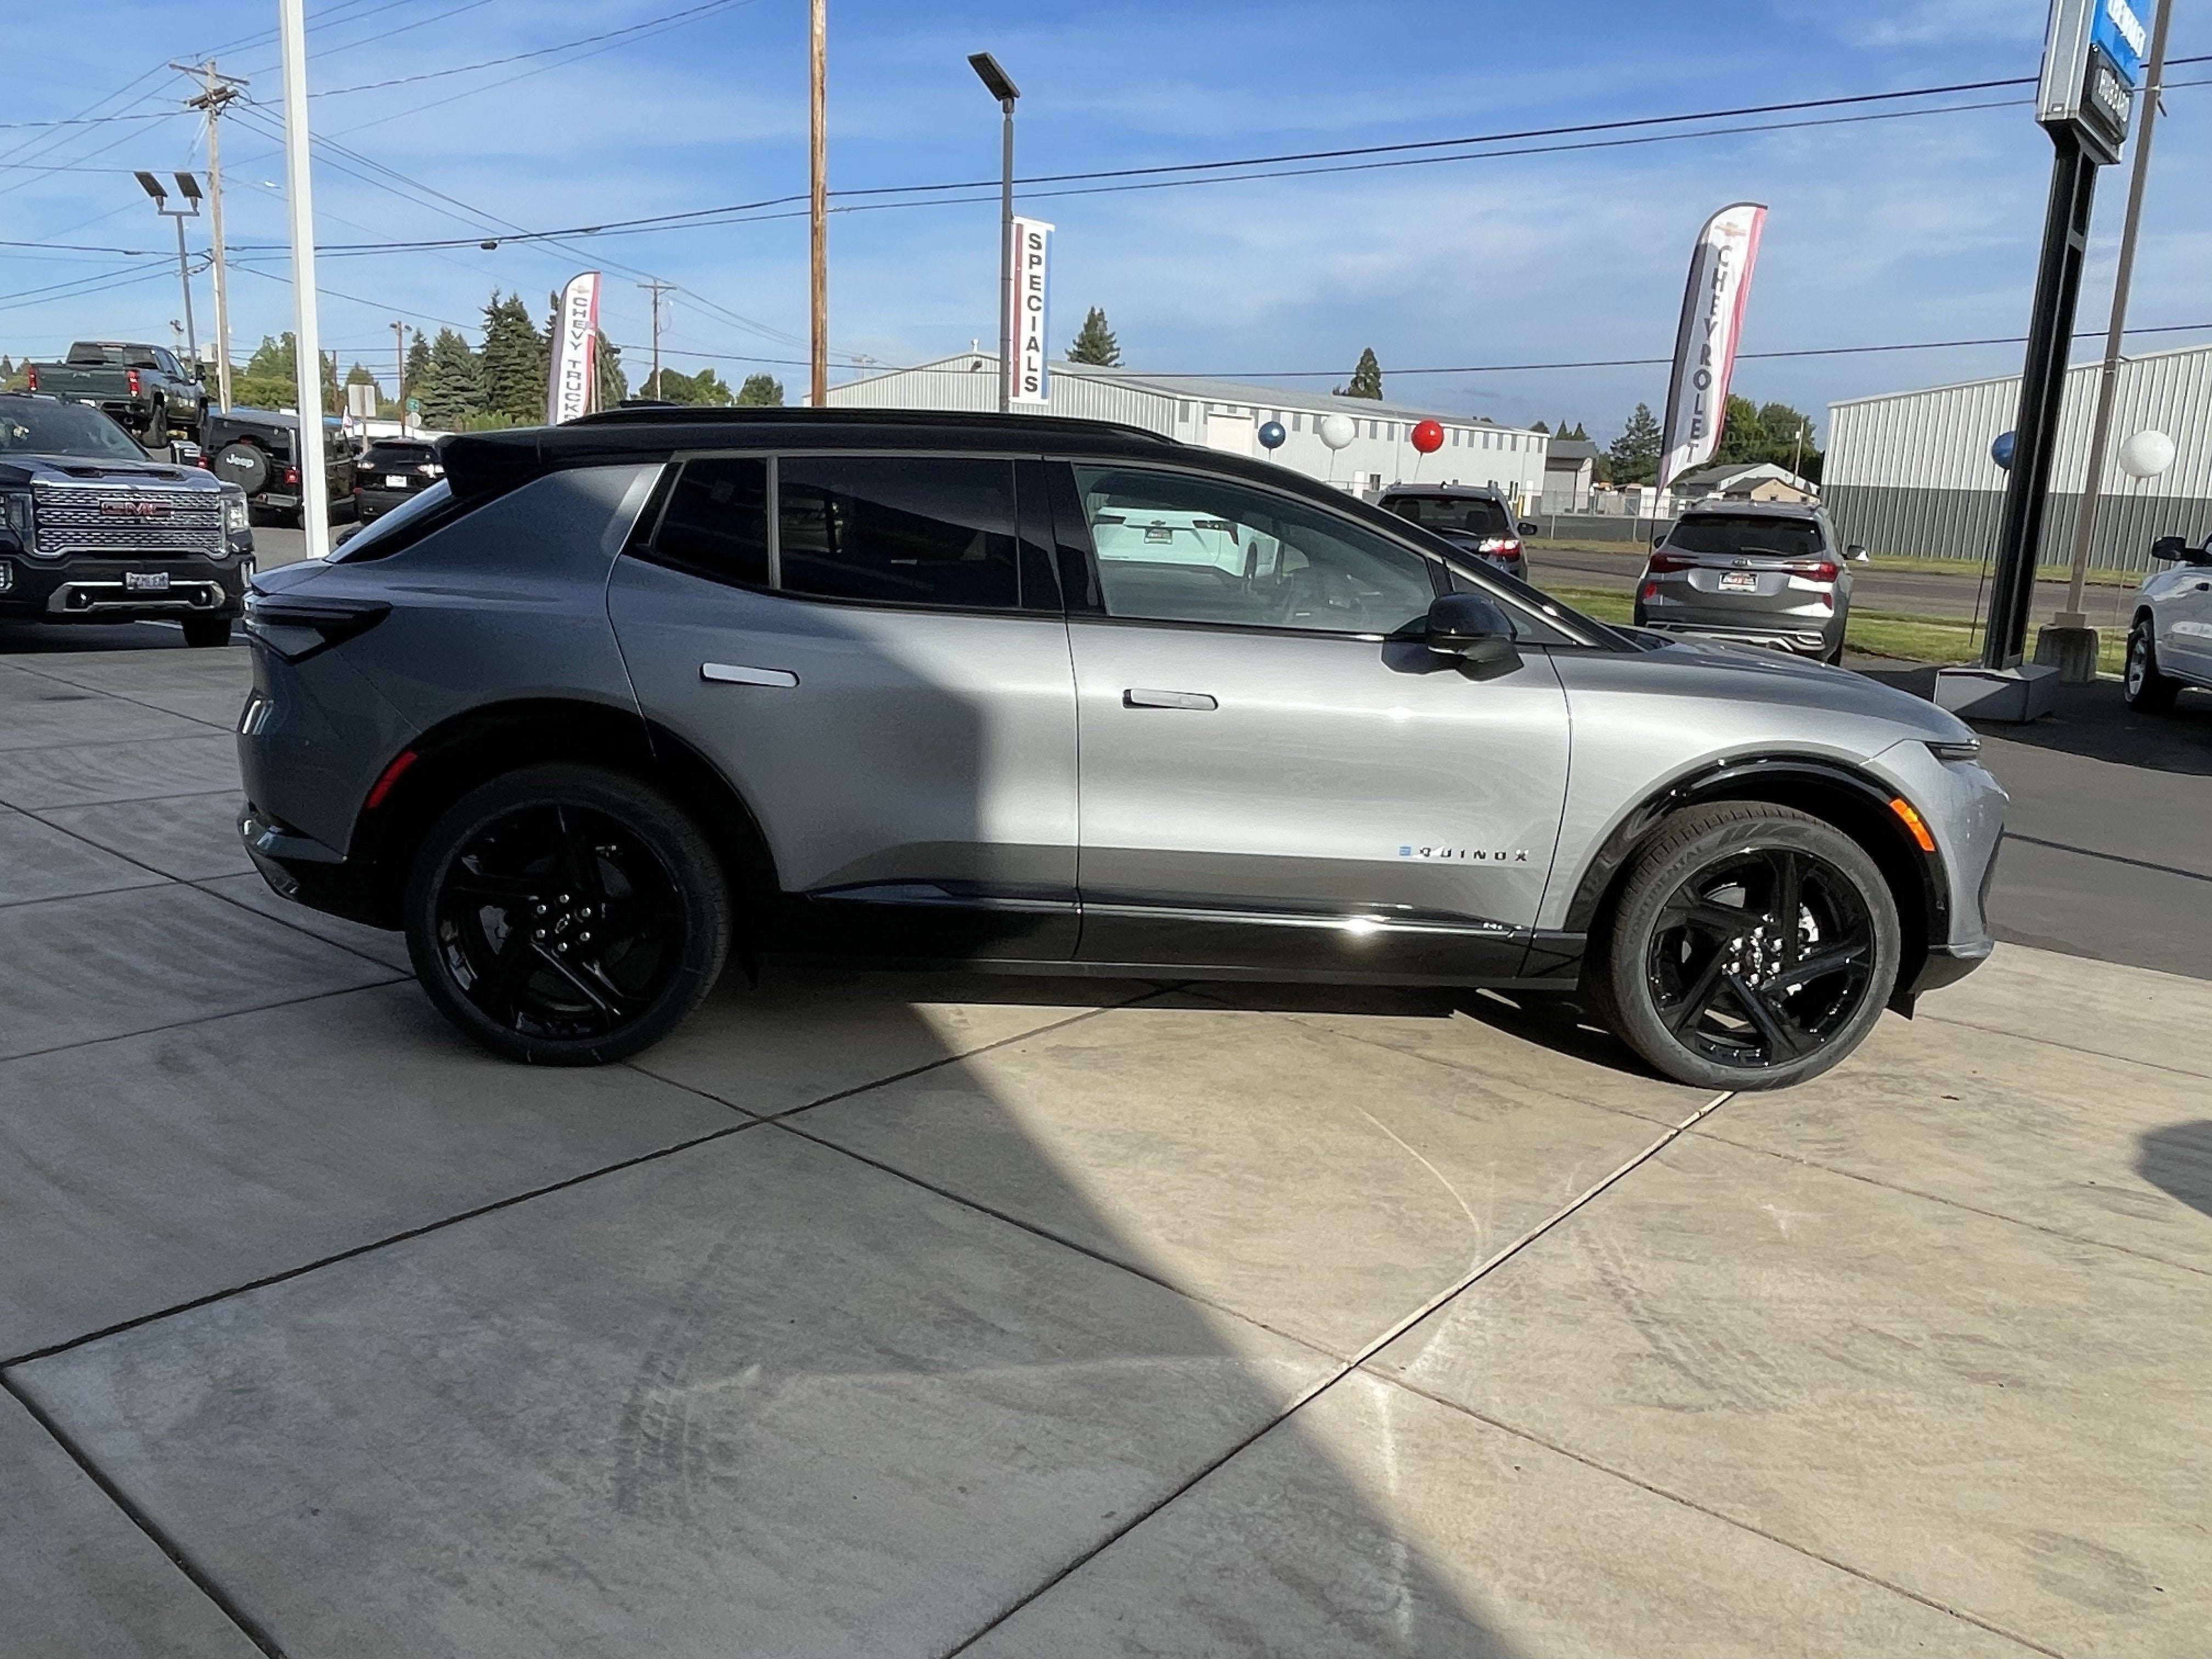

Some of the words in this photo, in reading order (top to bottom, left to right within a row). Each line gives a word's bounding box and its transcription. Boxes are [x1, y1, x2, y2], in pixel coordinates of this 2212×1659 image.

[569, 297, 588, 351] CHEVY
[1024, 233, 1042, 392] SPECIALS
[1686, 245, 1732, 463] CHEVROLET
[226, 453, 255, 468] Jeep
[1400, 846, 1528, 862] EQUINOX
